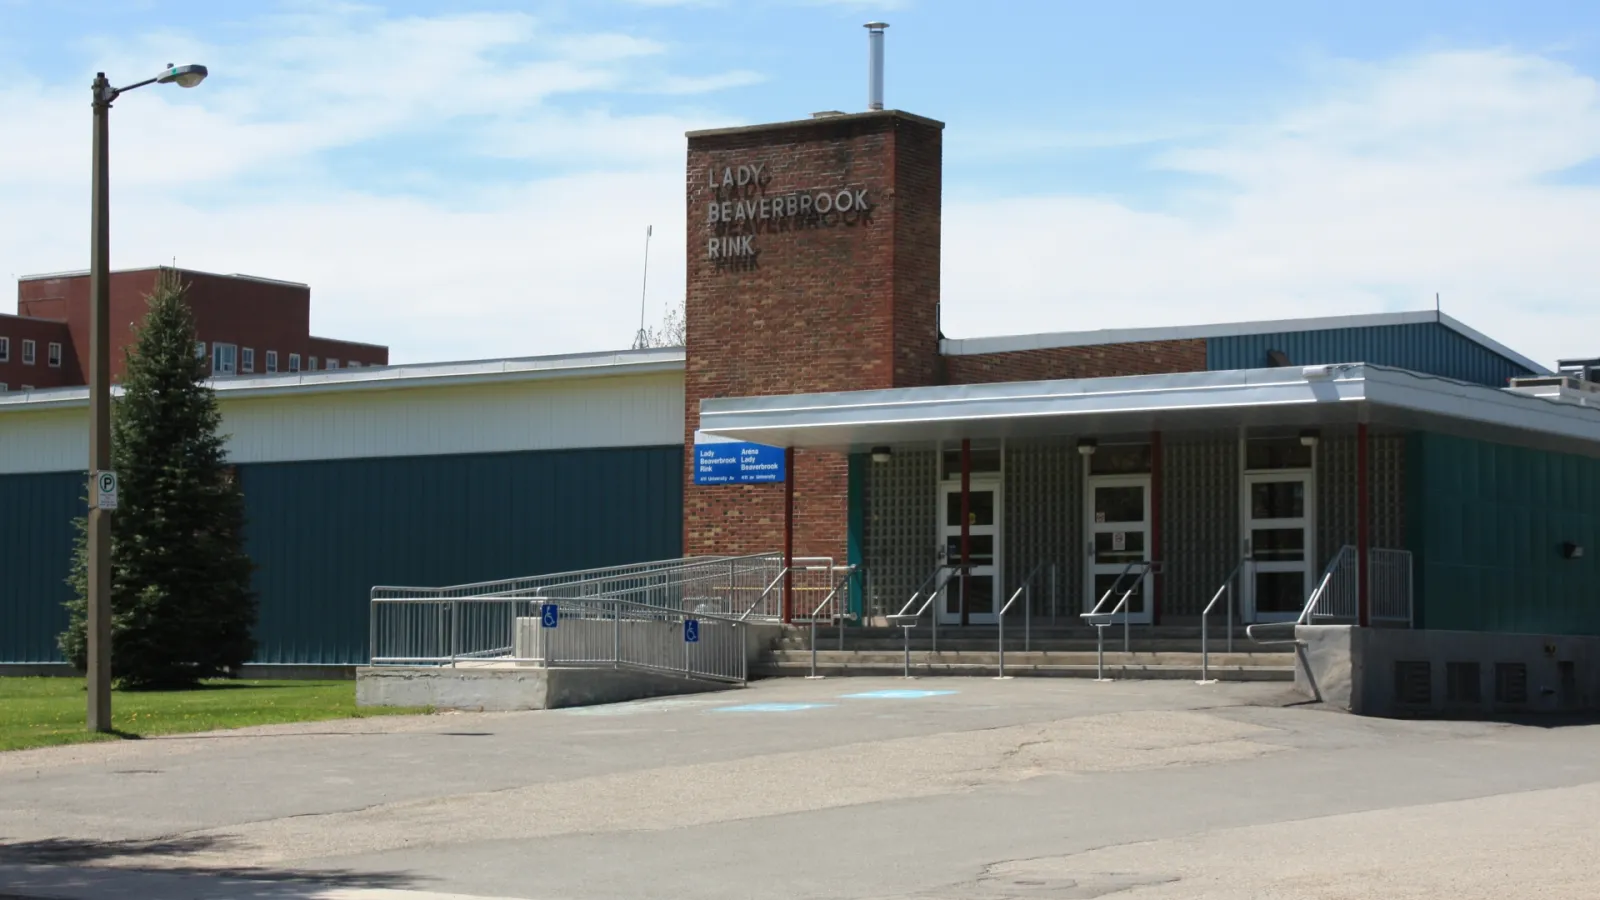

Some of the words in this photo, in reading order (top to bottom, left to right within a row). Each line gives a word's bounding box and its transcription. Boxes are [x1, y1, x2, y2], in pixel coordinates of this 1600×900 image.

[709, 164, 764, 188] LADY
[708, 189, 868, 222] BEAVERBROOK
[708, 235, 755, 259] RINK
[700, 450, 714, 458] Lady
[700, 457, 736, 465] Beaverbrook
[741, 456, 755, 464] Lady
[741, 463, 778, 471] Beaverbrook
[104, 477, 112, 489] P
